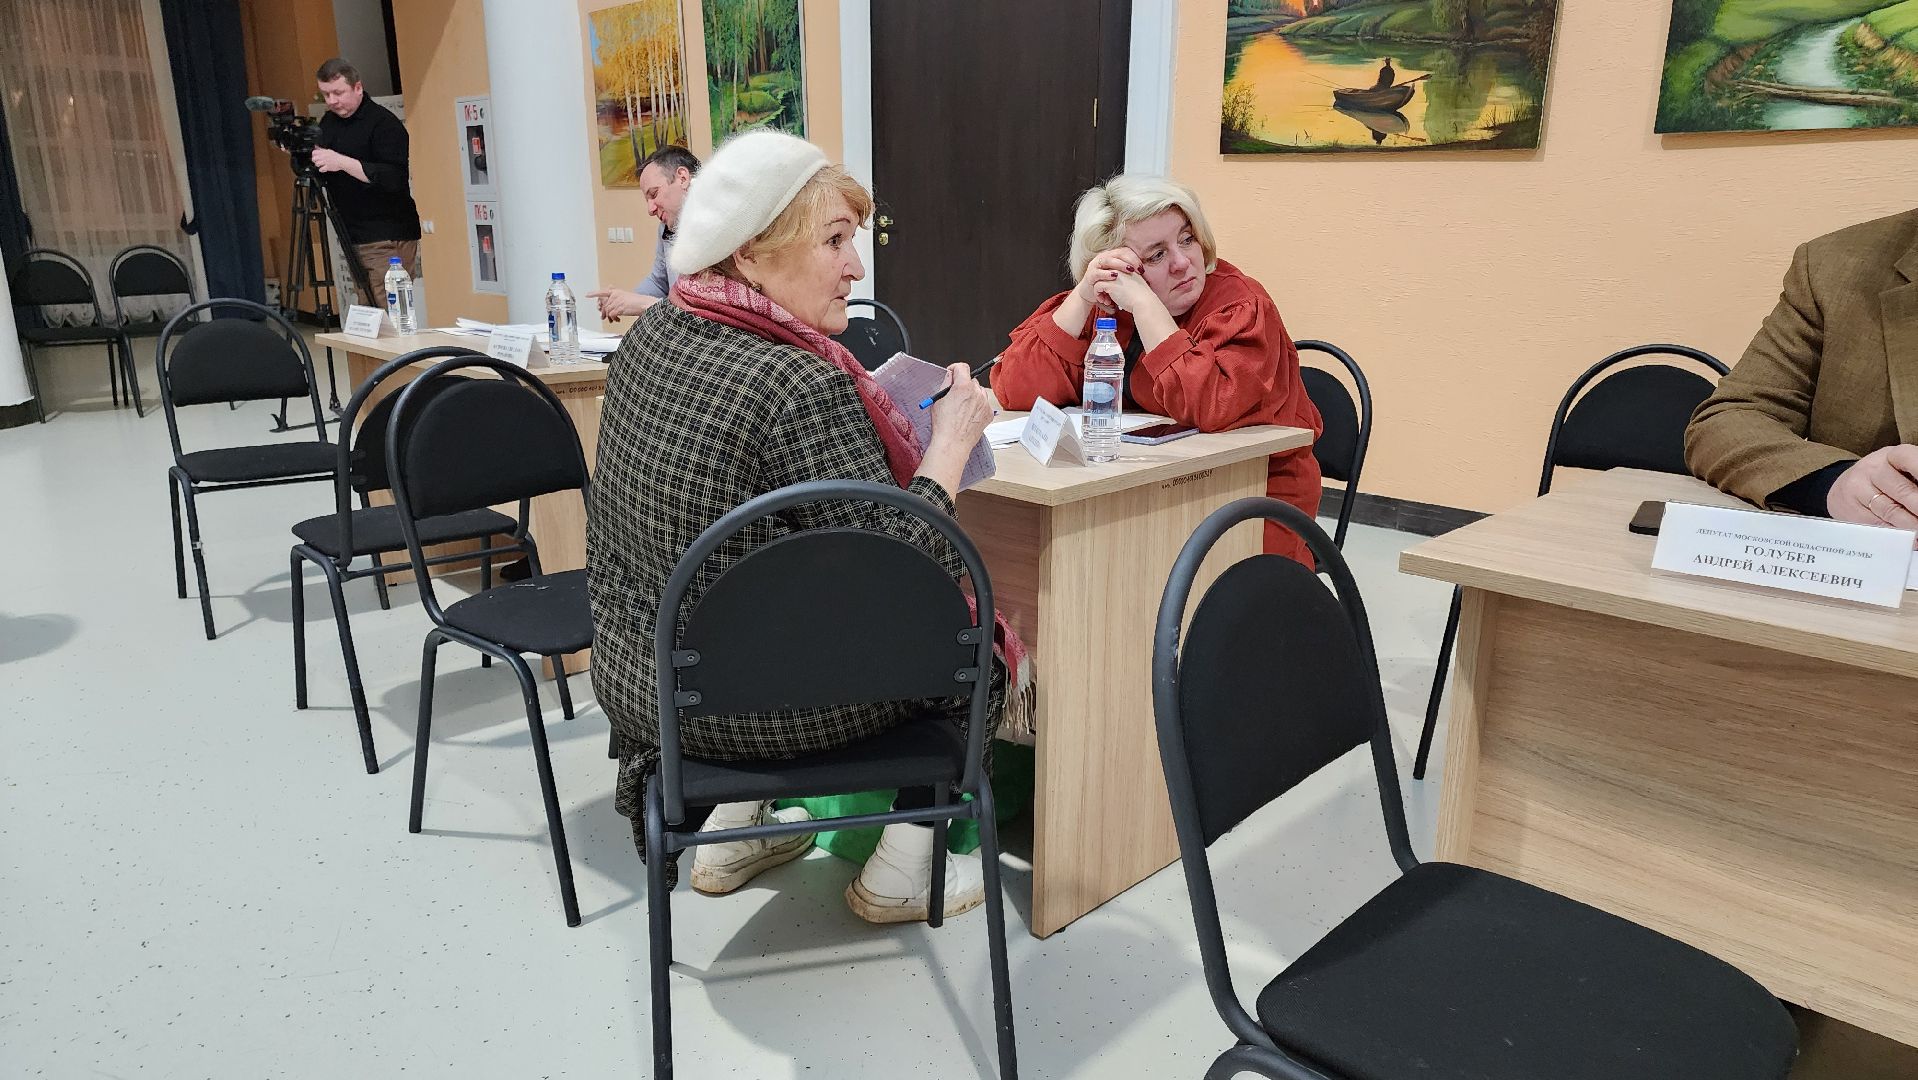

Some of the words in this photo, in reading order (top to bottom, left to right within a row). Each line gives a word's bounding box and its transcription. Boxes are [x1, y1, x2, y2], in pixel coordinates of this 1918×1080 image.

[1696, 528, 1734, 538] ДЕПУТАТ
[1735, 533, 1791, 547] МОСКОВСКОЙ
[1793, 541, 1845, 555] ОБЛАСТНОЙ
[1846, 550, 1873, 559] ДУМЫ
[1744, 545, 1816, 564] ГОЛУБЕВ
[1693, 553, 1753, 572] АНДРЕЙ
[1756, 563, 1864, 588] АЛЕКСЕЕВИЧ
